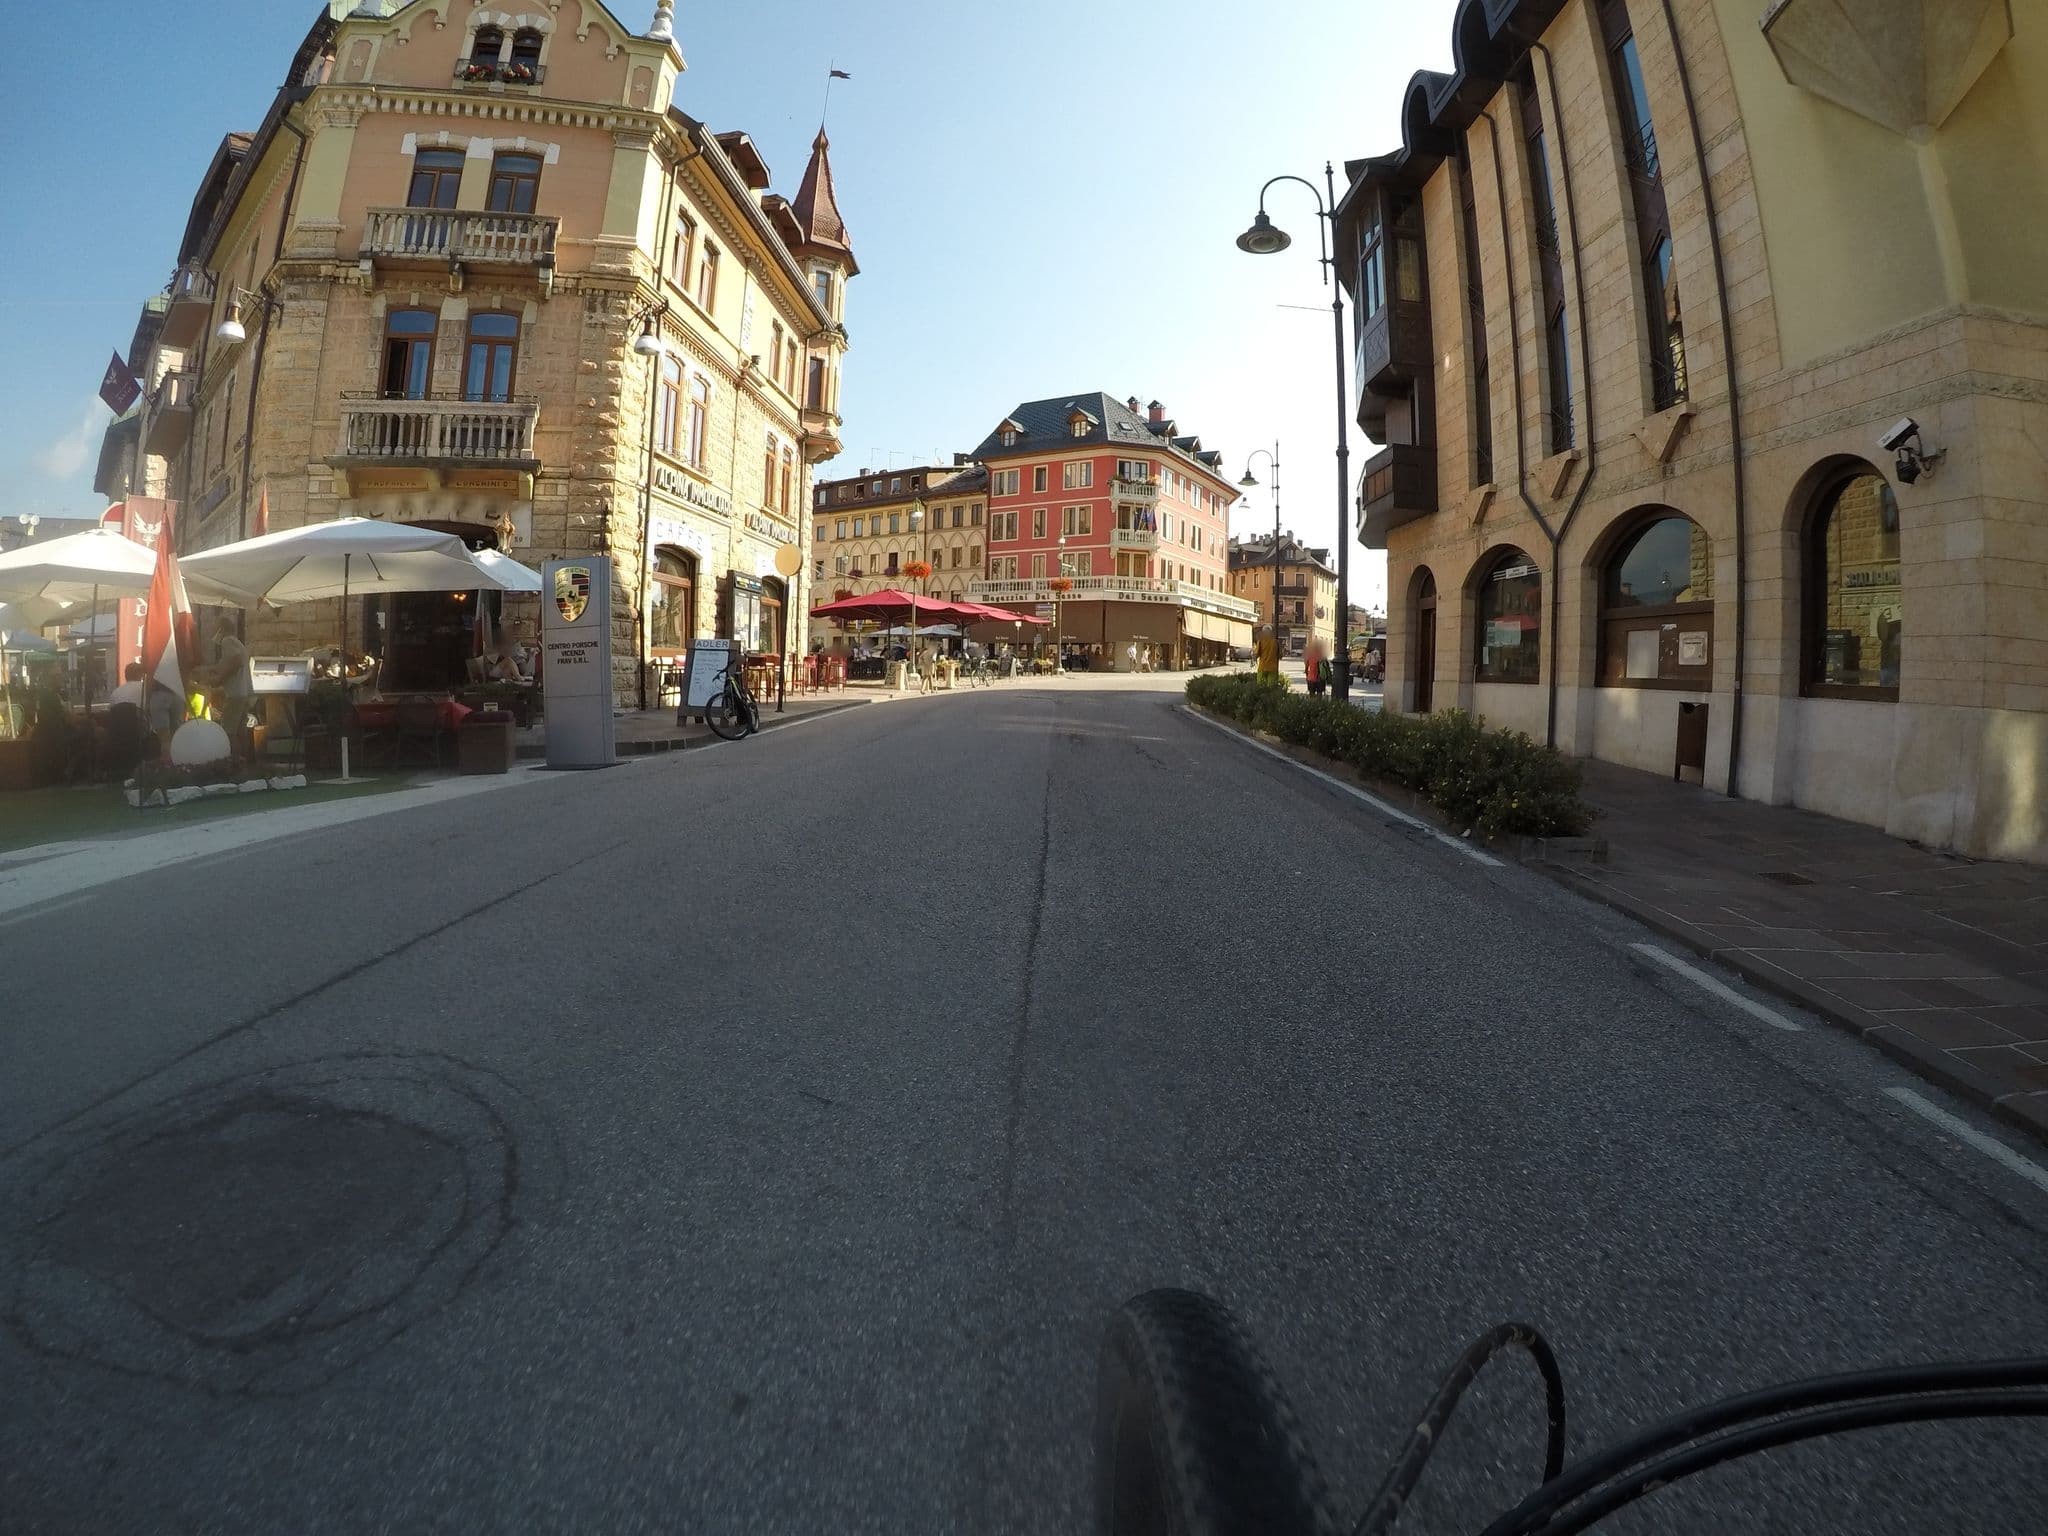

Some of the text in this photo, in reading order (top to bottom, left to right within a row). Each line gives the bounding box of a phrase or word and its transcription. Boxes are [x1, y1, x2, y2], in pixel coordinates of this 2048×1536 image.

[655, 467, 687, 500] ALPINA
[982, 591, 1082, 602] Magazzini Dal Sasso
[1118, 592, 1170, 602] Dal Sasso
[547, 640, 599, 650] CENTRO PORSCHE
[695, 640, 729, 648] ADLER
